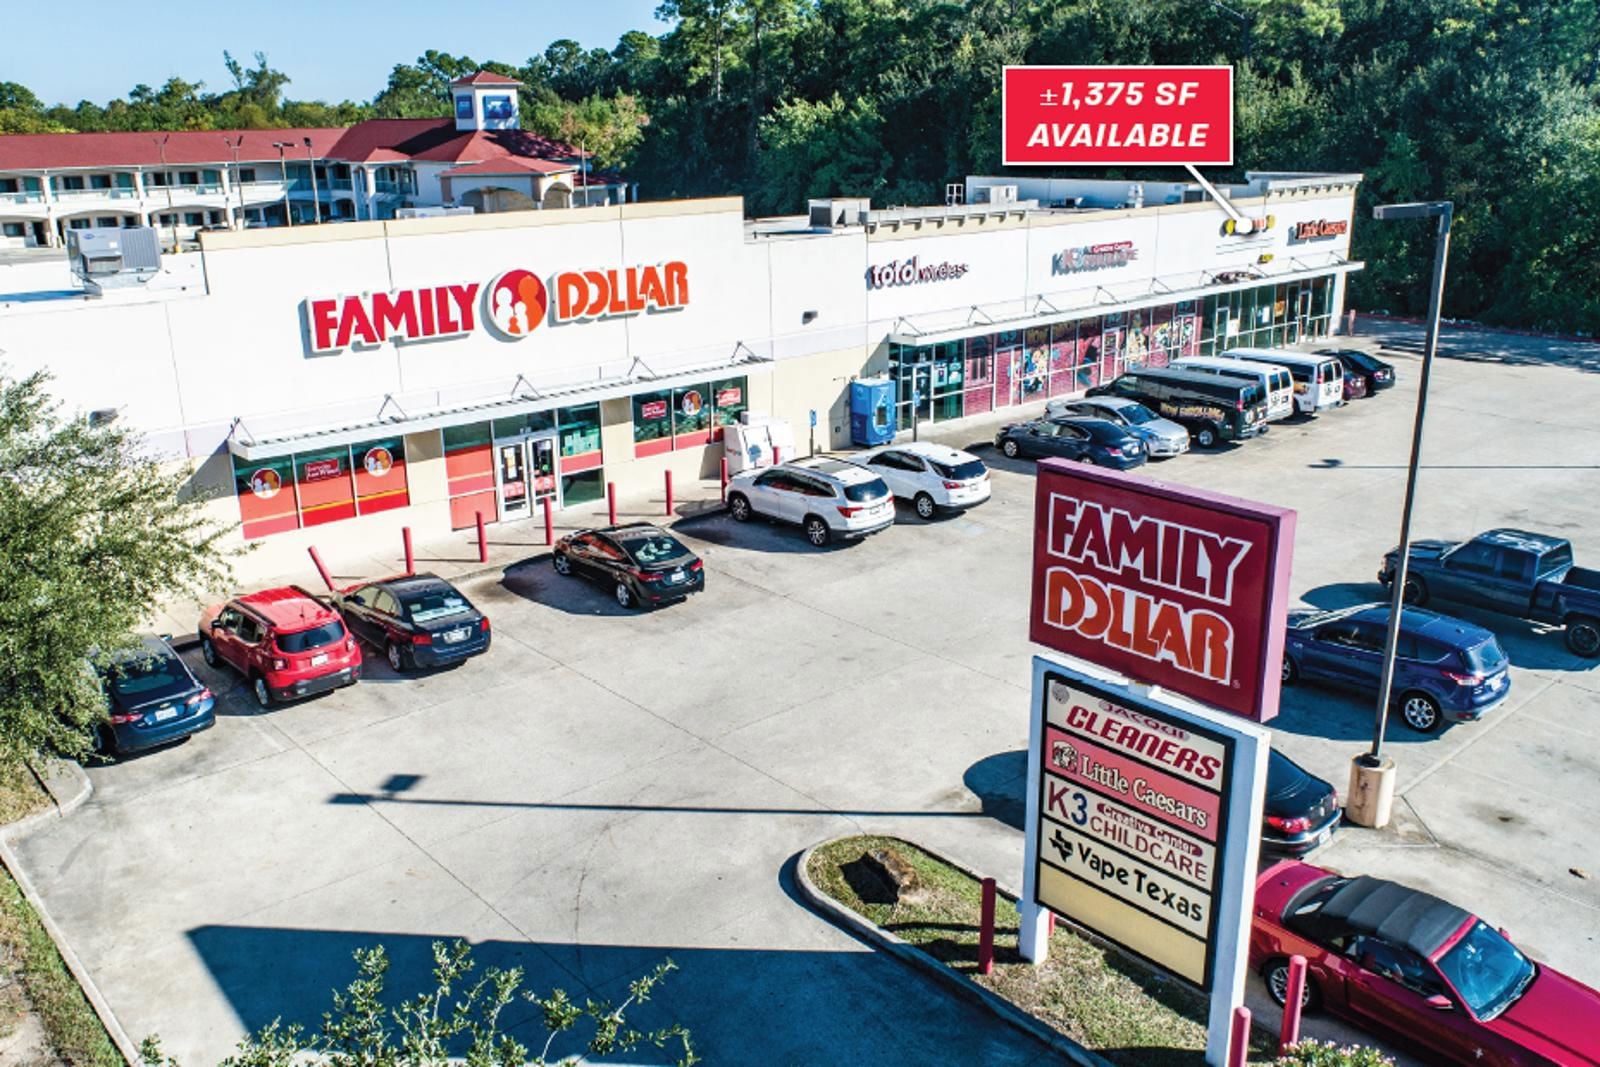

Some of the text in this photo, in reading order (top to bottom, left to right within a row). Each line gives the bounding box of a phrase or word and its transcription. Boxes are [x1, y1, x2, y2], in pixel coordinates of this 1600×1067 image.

[311, 260, 690, 351] FAMILY DOLLAR
[1047, 492, 1253, 606] FAMILY
[1044, 566, 1235, 685] DOLLAR
[1066, 705, 1221, 780] CLEANERS
[1048, 781, 1088, 826] K3
[1081, 754, 1207, 829] Little Caesars
[1090, 815, 1208, 882] CHILDCARE
[1102, 804, 1196, 855] Creative Center
[1077, 842, 1203, 922] Vape Texas
